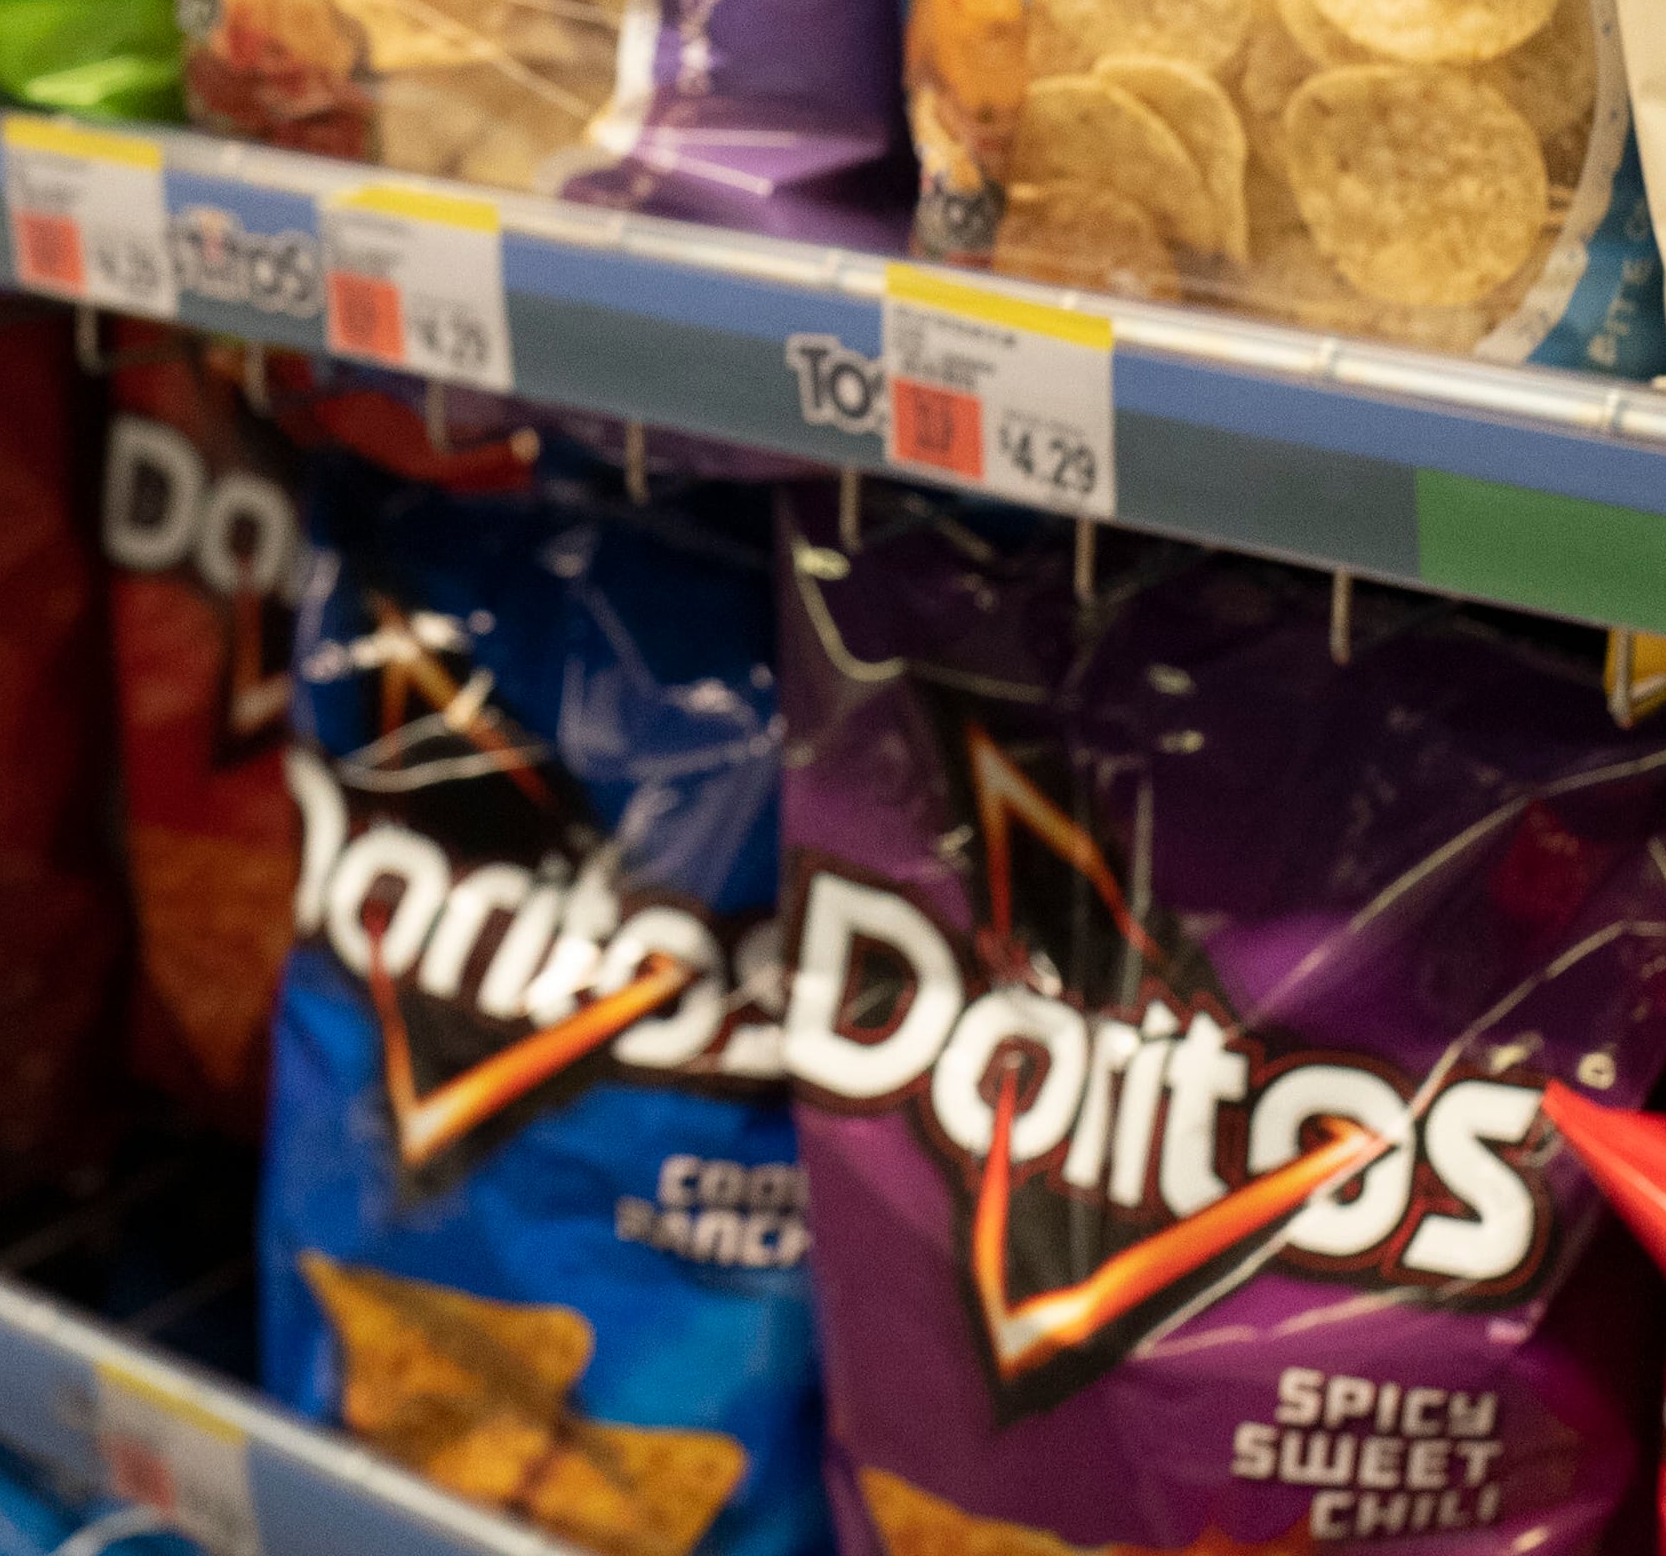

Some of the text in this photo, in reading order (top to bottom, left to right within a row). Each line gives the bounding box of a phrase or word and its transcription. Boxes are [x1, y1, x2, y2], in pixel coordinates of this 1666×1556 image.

[784, 870, 1545, 1282] Doritos
[1276, 1366, 1498, 1435] SPICY
[1230, 1422, 1501, 1488] SWEET
[1311, 1489, 1500, 1543] CHILI
